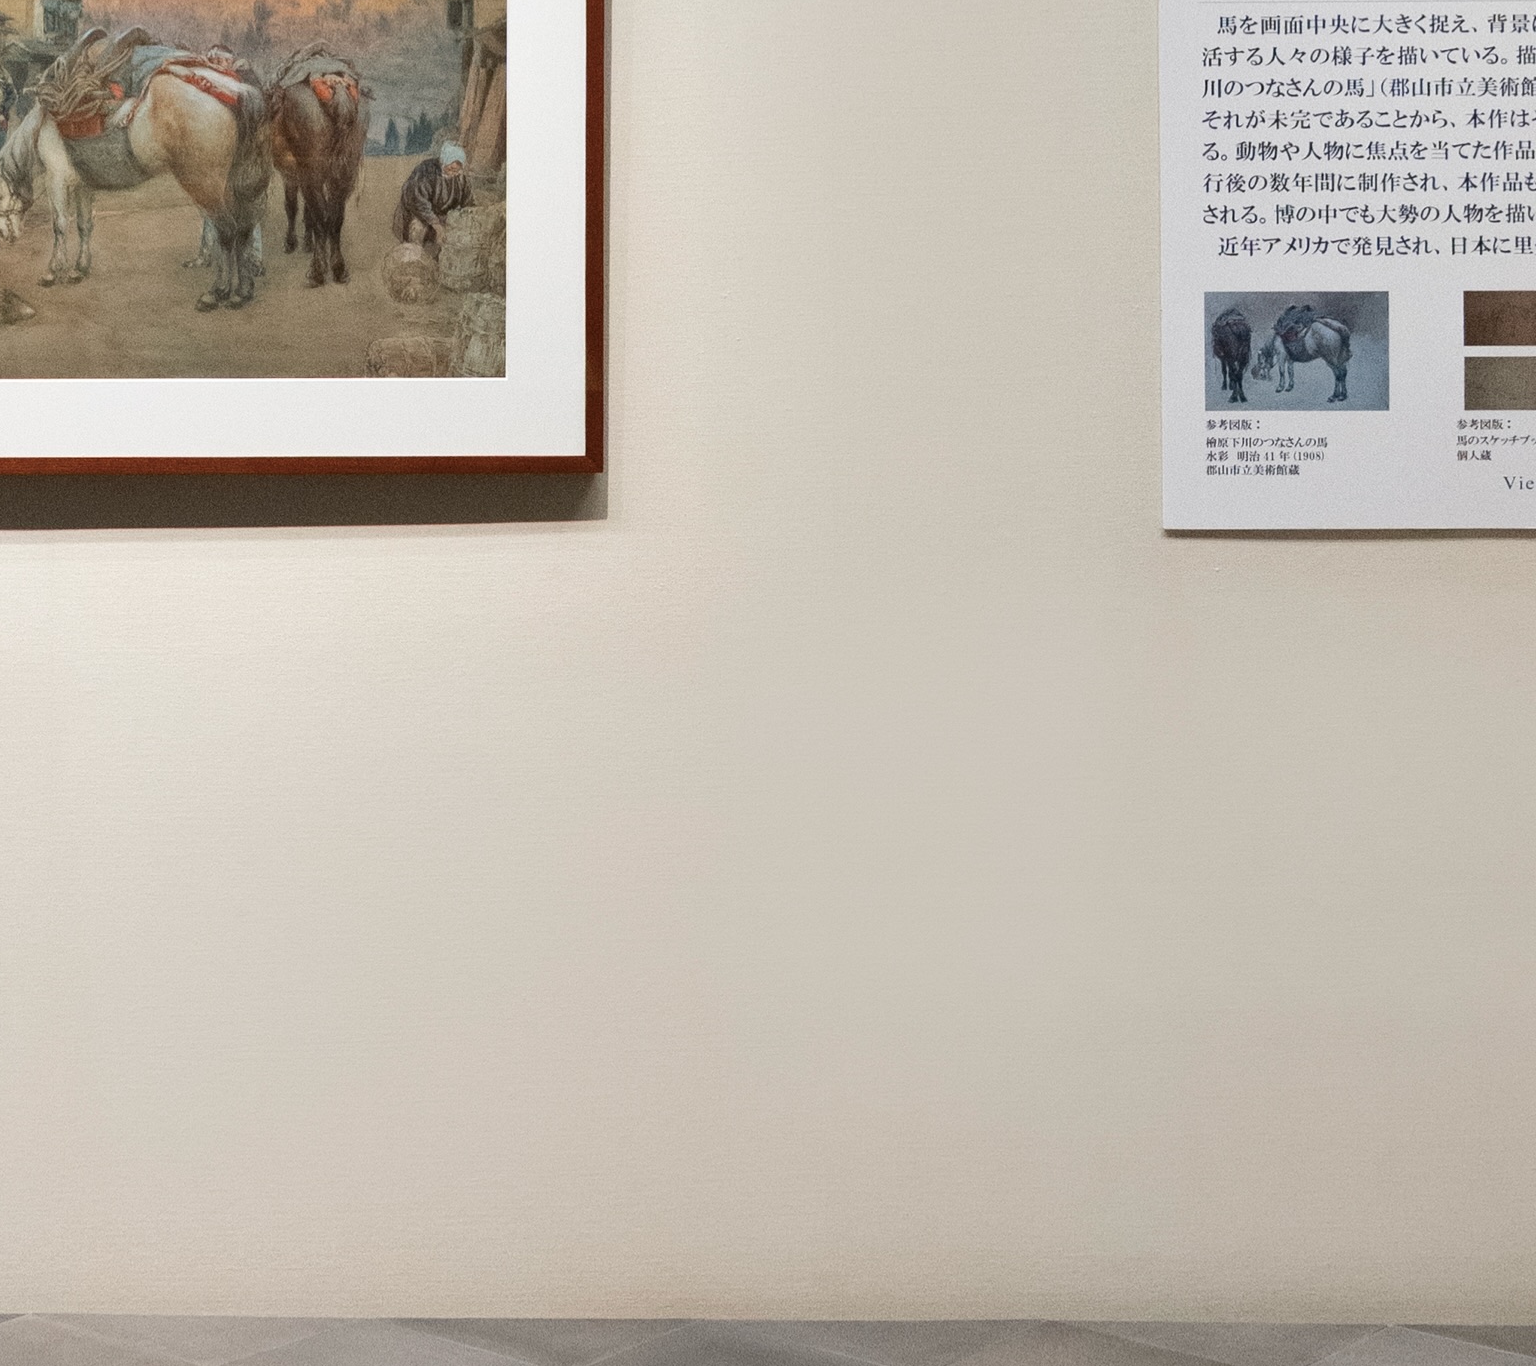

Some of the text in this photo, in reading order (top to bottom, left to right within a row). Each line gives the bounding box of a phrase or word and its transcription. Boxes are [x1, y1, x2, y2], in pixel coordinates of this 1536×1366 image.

[1217, 14, 1536, 35] 馬を画面中央に大きく捉え、背景
[1202, 109, 1536, 129] それが未完であることから、本作は
[1203, 141, 1535, 161] る。動物や人物に焦点を当てた作品
[1204, 172, 1536, 193] 行後の数年間に制作され、本作品も
[1219, 236, 1536, 256] 近年アメリカで発見され、日本に里
[1207, 451, 1228, 462] 水彩
[1457, 450, 1491, 461] 個人蔵
[1207, 465, 1299, 475] 郡山市立美術館蔵
